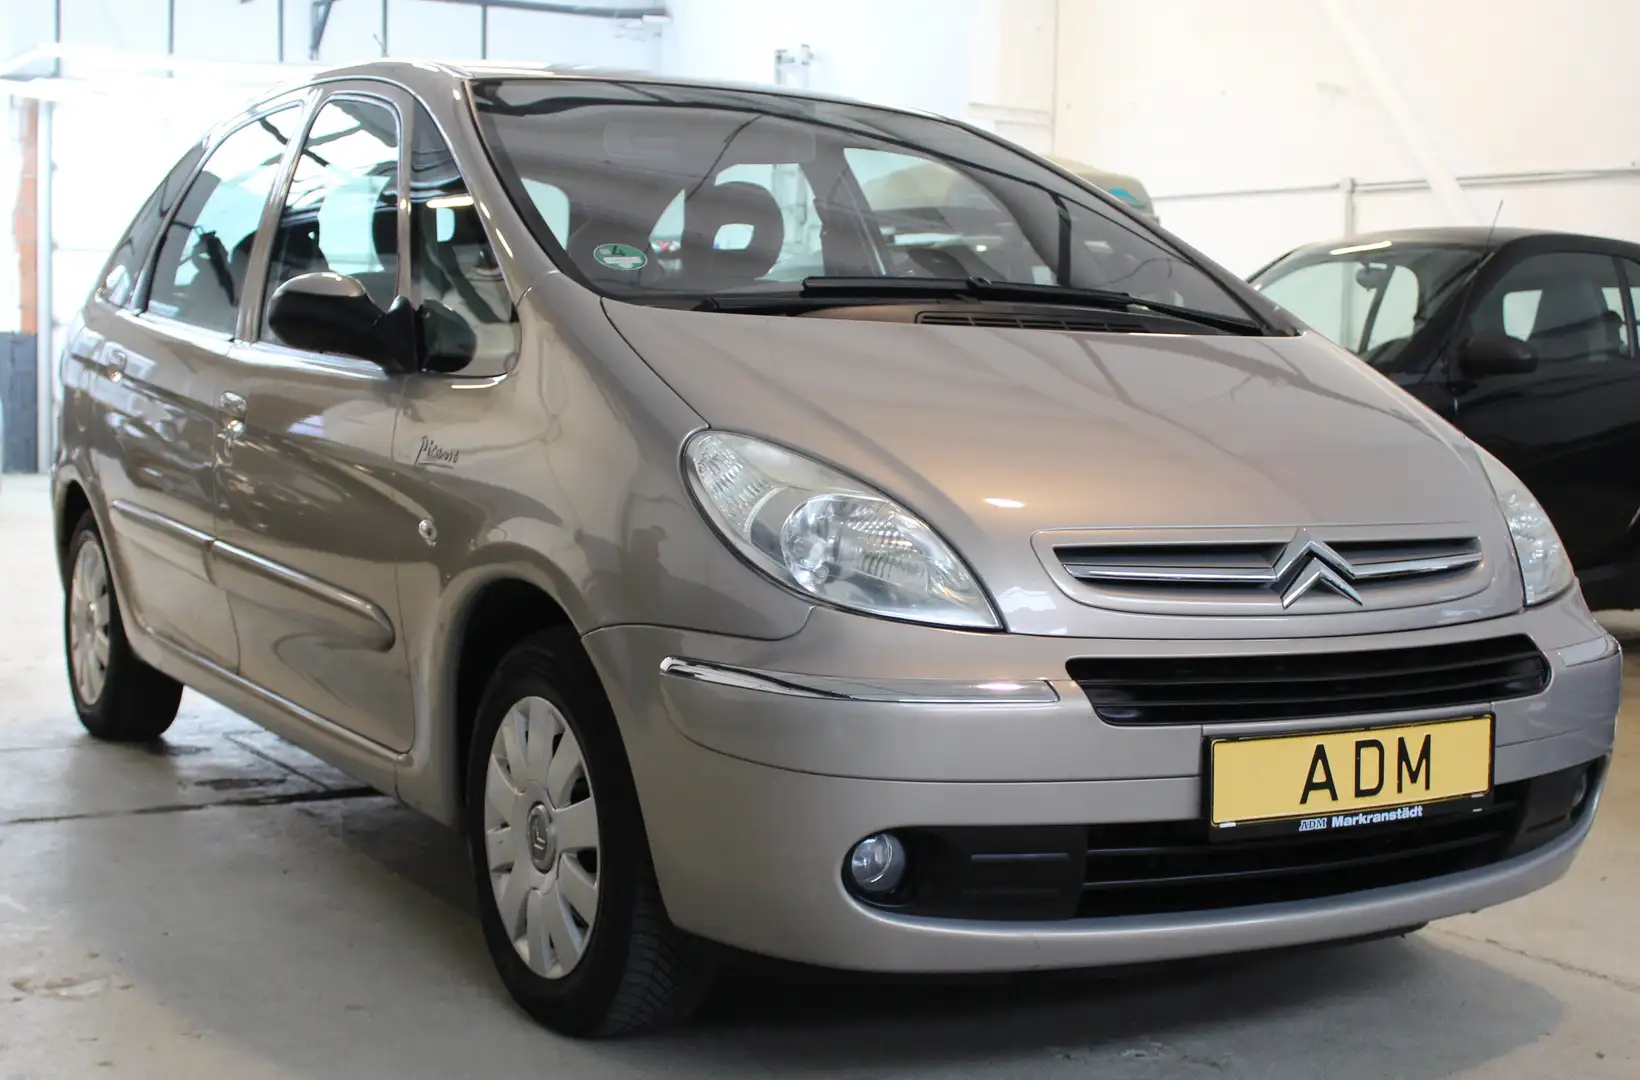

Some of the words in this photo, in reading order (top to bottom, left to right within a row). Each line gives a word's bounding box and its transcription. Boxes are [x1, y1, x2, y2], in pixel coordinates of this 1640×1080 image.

[1300, 734, 1431, 804] ADM
[1299, 817, 1328, 831] ADM
[1331, 805, 1423, 828] Markranstädt
